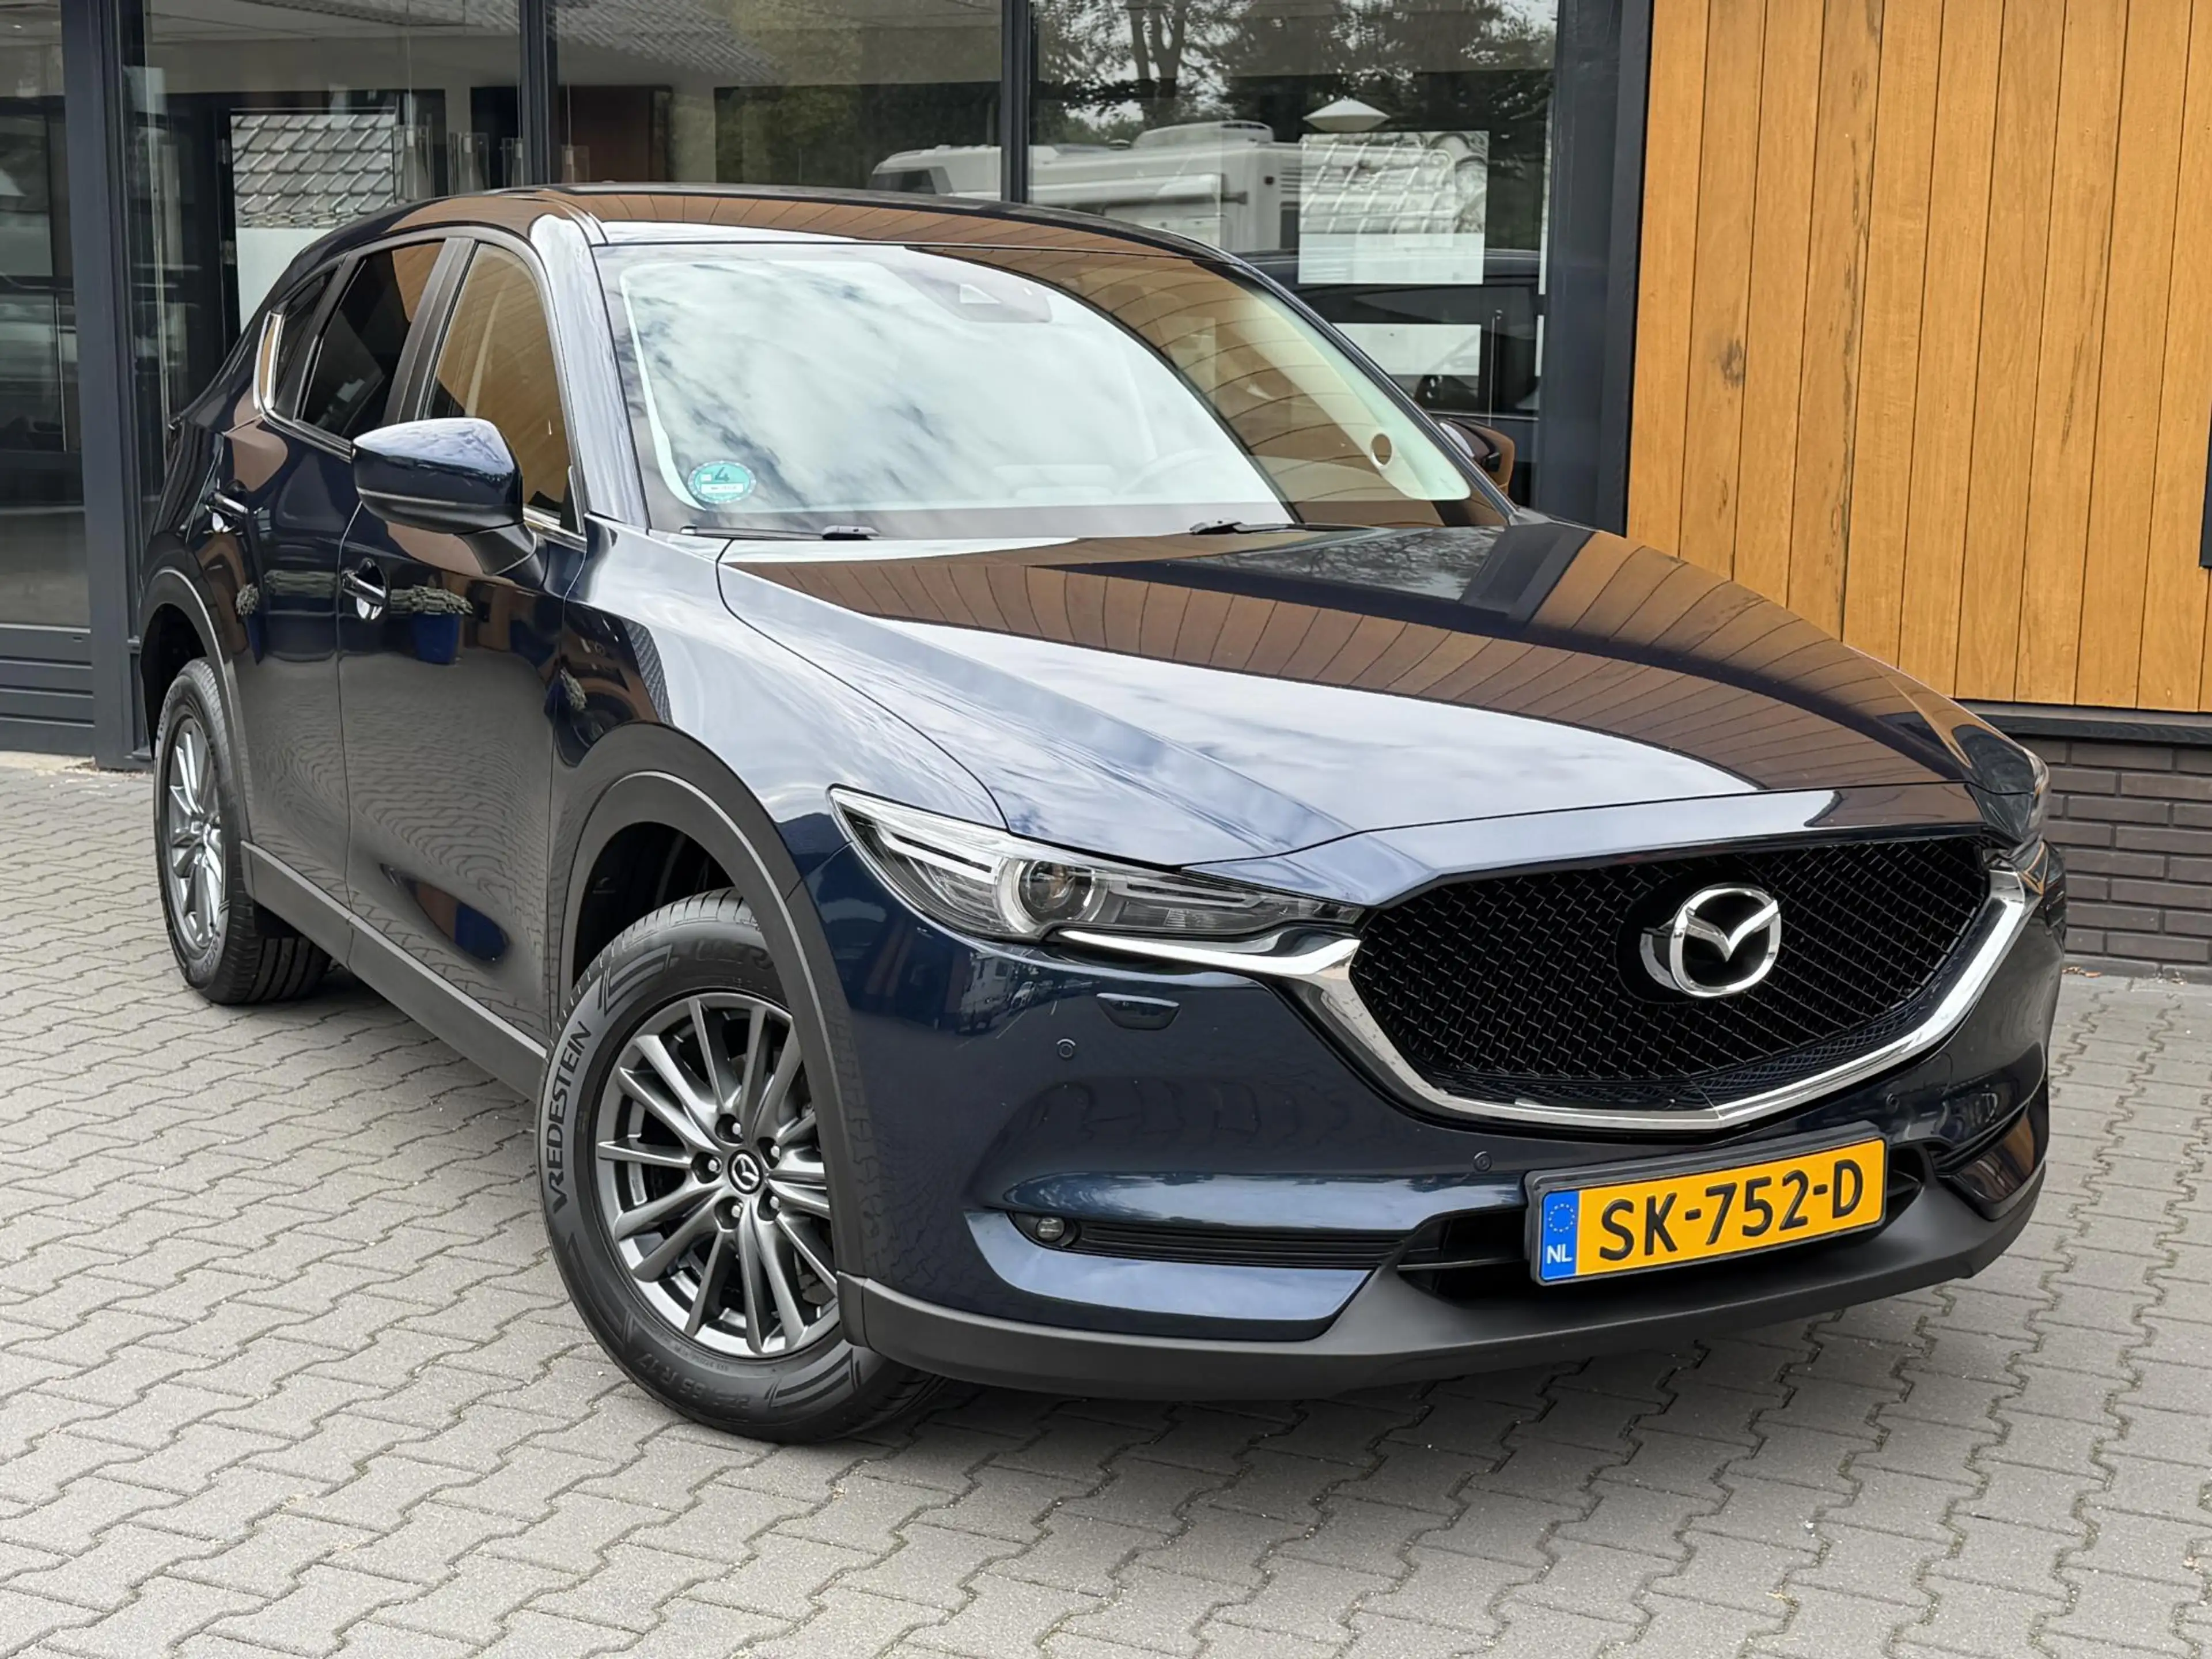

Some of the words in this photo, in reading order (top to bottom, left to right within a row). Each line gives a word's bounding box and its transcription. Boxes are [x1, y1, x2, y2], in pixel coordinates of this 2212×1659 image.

[547, 1020, 592, 1214] VREDESTEIN
[1547, 1243, 1573, 1264] NL
[1599, 1158, 1863, 1261] SK-752-D
